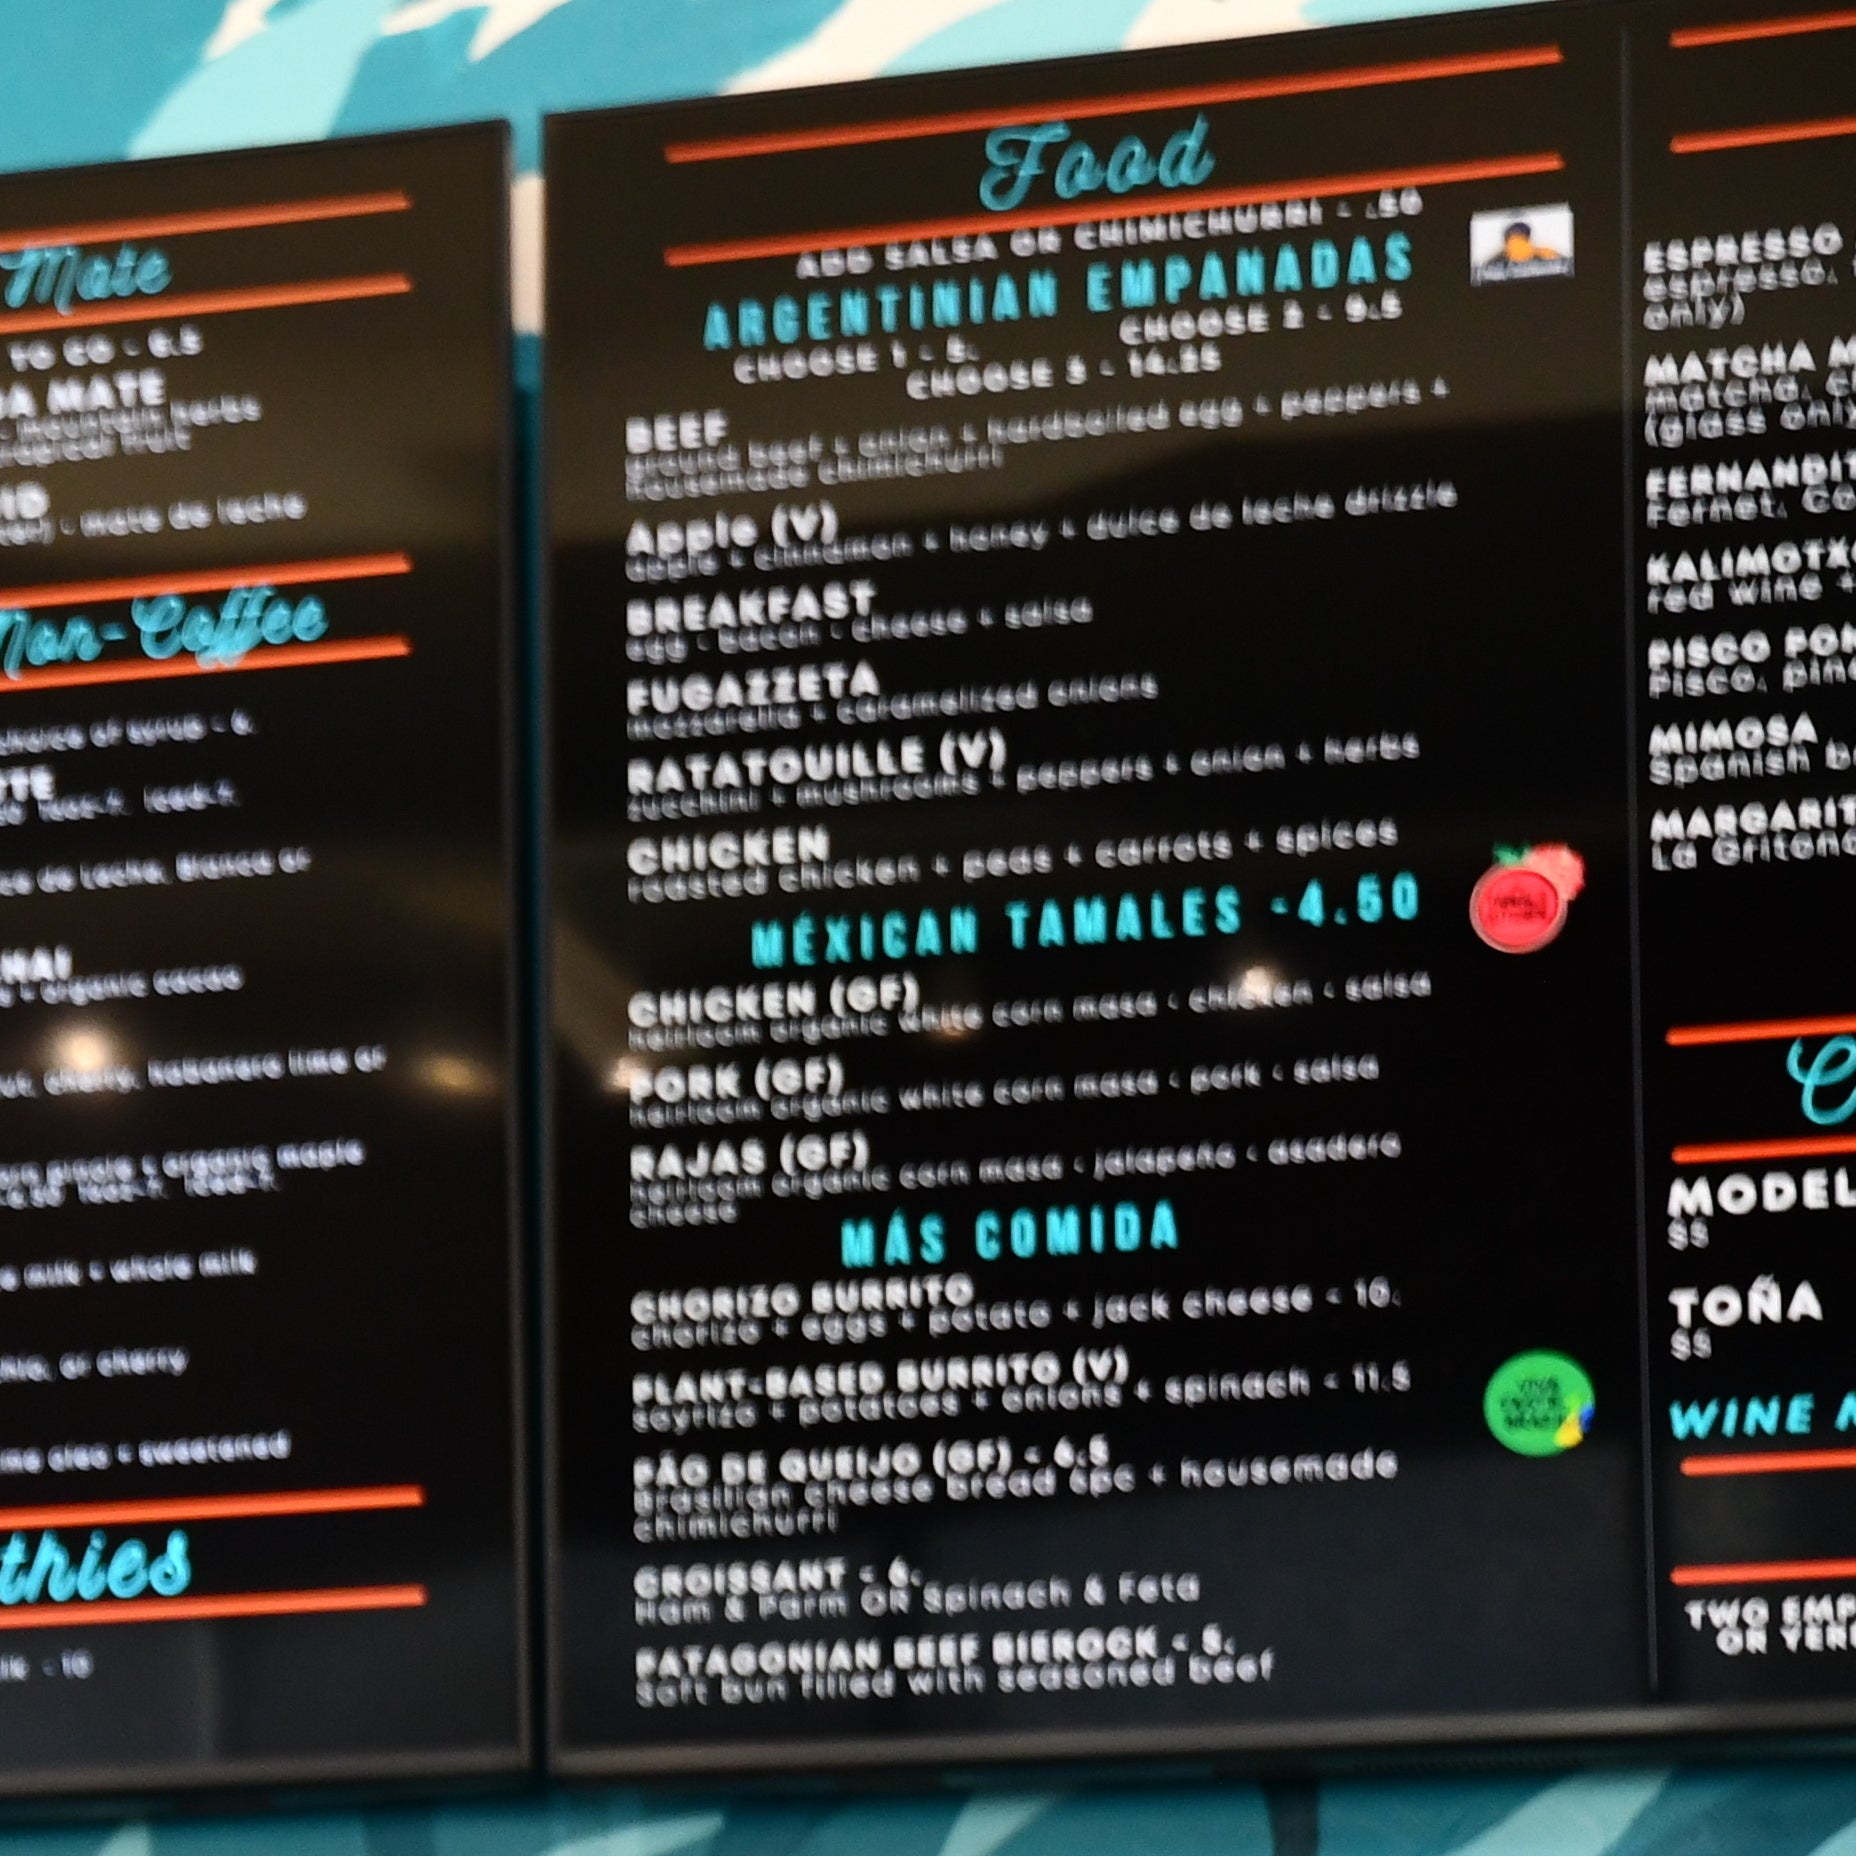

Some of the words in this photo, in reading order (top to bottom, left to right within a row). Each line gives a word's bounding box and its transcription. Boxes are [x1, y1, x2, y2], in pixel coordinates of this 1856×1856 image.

[979, 119, 1214, 210] Food
[1644, 222, 1843, 274] ESPRESSO
[705, 272, 1057, 348] ARGENTINIAN
[1087, 233, 1411, 312] EMPANADAS
[1118, 302, 1269, 348] CHOOSE
[732, 342, 878, 386] CHOOSE
[905, 356, 1054, 402] CHOOSE
[1644, 339, 1816, 387] MATCHA
[624, 407, 728, 457] BEEF
[624, 508, 758, 563] Apple
[769, 497, 840, 549] (V)
[1646, 536, 1856, 585] KALIMOTX
[624, 575, 877, 640] BREAKFAST
[1648, 629, 1772, 671] PISCO
[625, 657, 881, 719] FUGAZZETA
[1648, 711, 1818, 756] MIMOSA
[625, 735, 926, 798] RATATOUILLE
[938, 726, 1008, 773] (V)
[1649, 744, 1811, 789] Spanish
[625, 822, 830, 879] CHICKEN
[1007, 886, 1241, 948] TAMALES
[626, 978, 817, 1031] CHICKEN
[828, 969, 922, 1017] (GF)
[628, 1060, 744, 1108] PORK
[752, 1052, 845, 1101] (GF)
[629, 1136, 767, 1186] RAJAS
[779, 1127, 870, 1176] (GF)
[841, 1212, 946, 1267] MÁS
[975, 1200, 1179, 1262] COMIDA
[629, 1282, 800, 1325] CHORIZO
[811, 1271, 976, 1314] BURRITO
[1668, 1273, 1824, 1328] TOÑA
[631, 1360, 885, 1408] PLANT-BASED
[896, 1350, 1060, 1392] BURRITO
[1072, 1343, 1130, 1386] (V)
[1669, 1393, 1815, 1441] WINE
[632, 1448, 711, 1493] PÃO
[721, 1450, 767, 1488] DE
[779, 1441, 920, 1486] QUEIJO
[931, 1435, 1013, 1479] (GF)
[1178, 1447, 1399, 1491] housemade
[633, 1554, 845, 1600] CROISSANT
[1684, 1597, 1769, 1631] TWO
[635, 1636, 880, 1681] PATAGONIAN
[893, 1631, 980, 1670] BEEF
[992, 1623, 1159, 1665] BIEROCK
